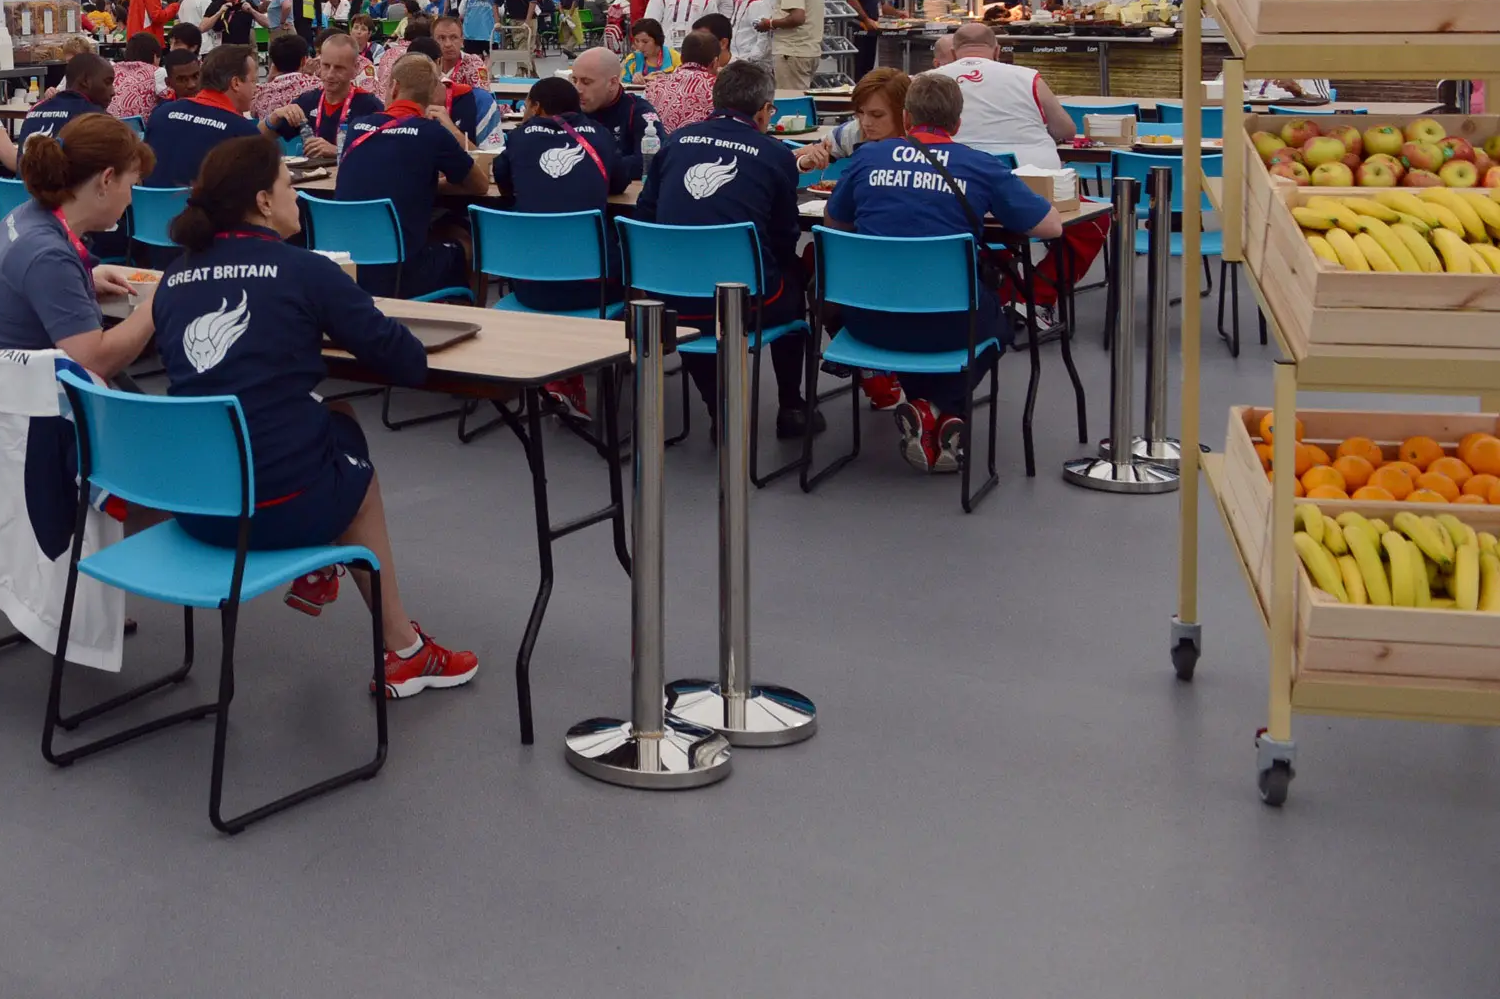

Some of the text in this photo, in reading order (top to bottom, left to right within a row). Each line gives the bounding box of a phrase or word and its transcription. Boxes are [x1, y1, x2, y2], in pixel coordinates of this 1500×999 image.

[42, 110, 69, 119] BRITAIN
[168, 111, 228, 131] GREAT BRITAIN
[353, 122, 380, 132] GREA
[524, 125, 555, 135] GREAT
[679, 135, 759, 157] GREAT BRITAIN
[892, 145, 950, 167] COAH
[869, 169, 967, 196] GREAT BRITAN
[167, 264, 278, 288] GREAT BRITAIN
